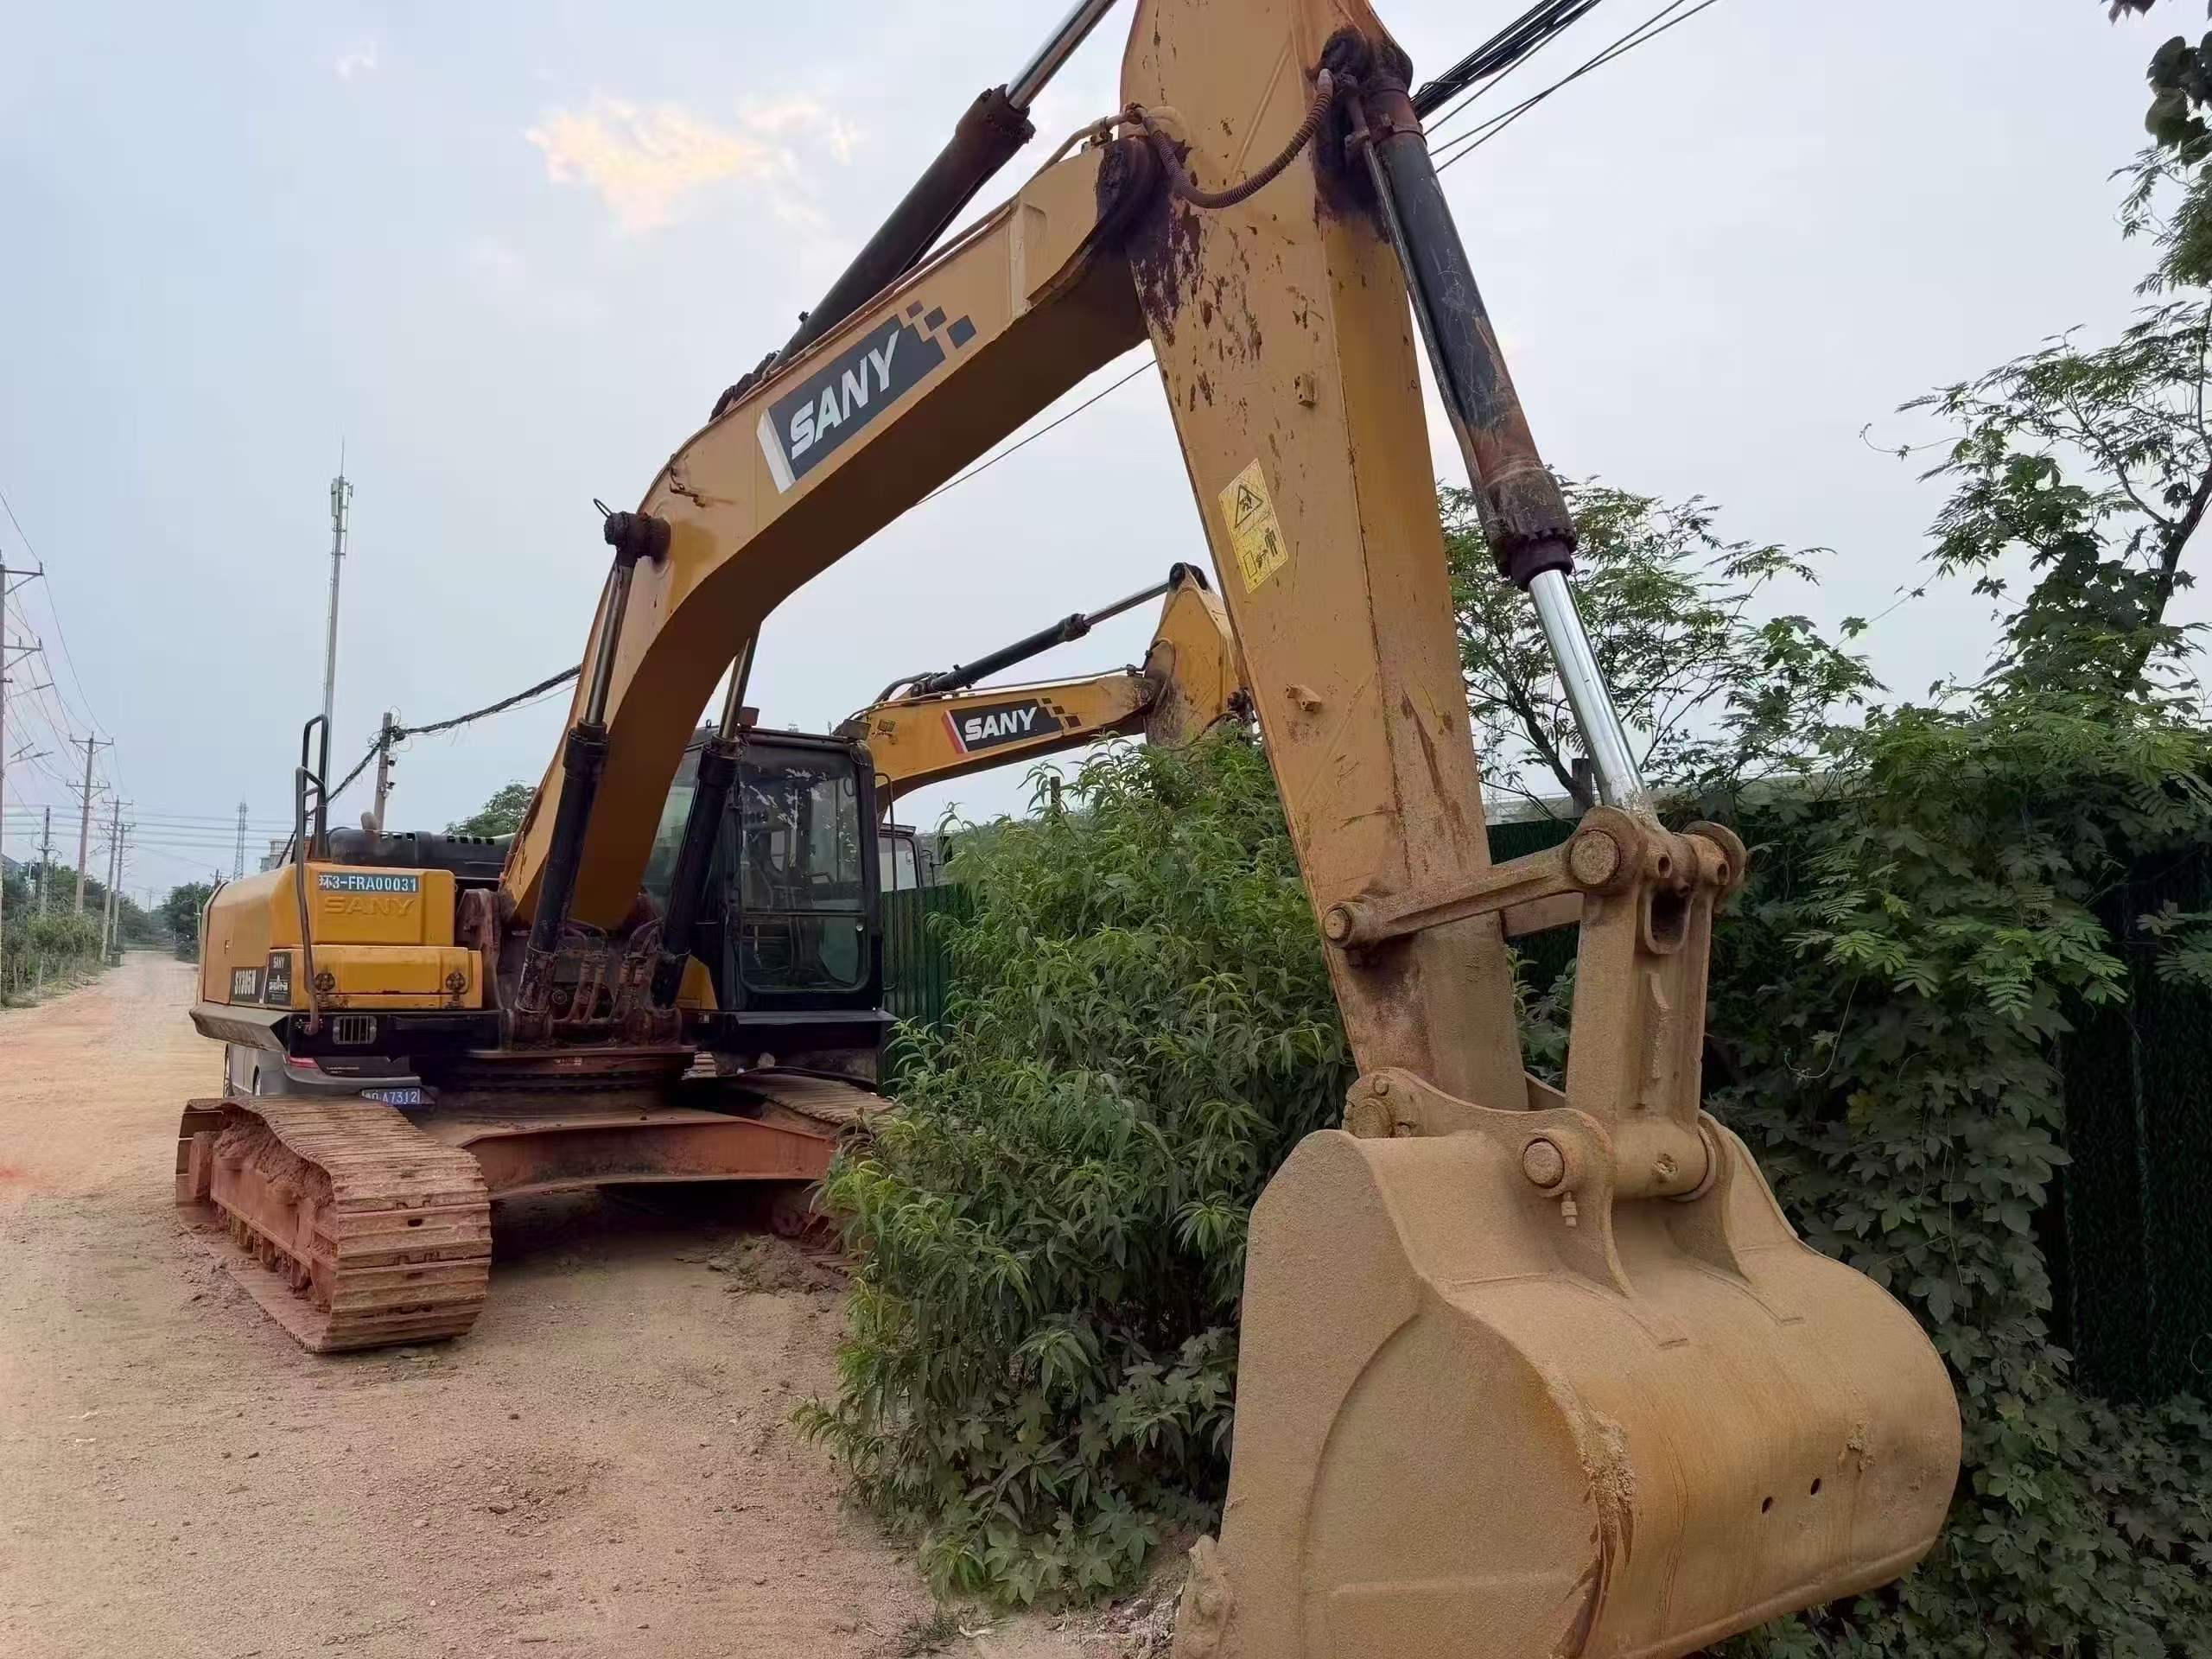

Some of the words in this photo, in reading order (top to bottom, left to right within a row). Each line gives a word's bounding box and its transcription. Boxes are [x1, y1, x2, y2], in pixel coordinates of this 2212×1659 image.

[790, 329, 899, 460] SANY
[964, 706, 1037, 741] SANY
[324, 896, 415, 916] SANY
